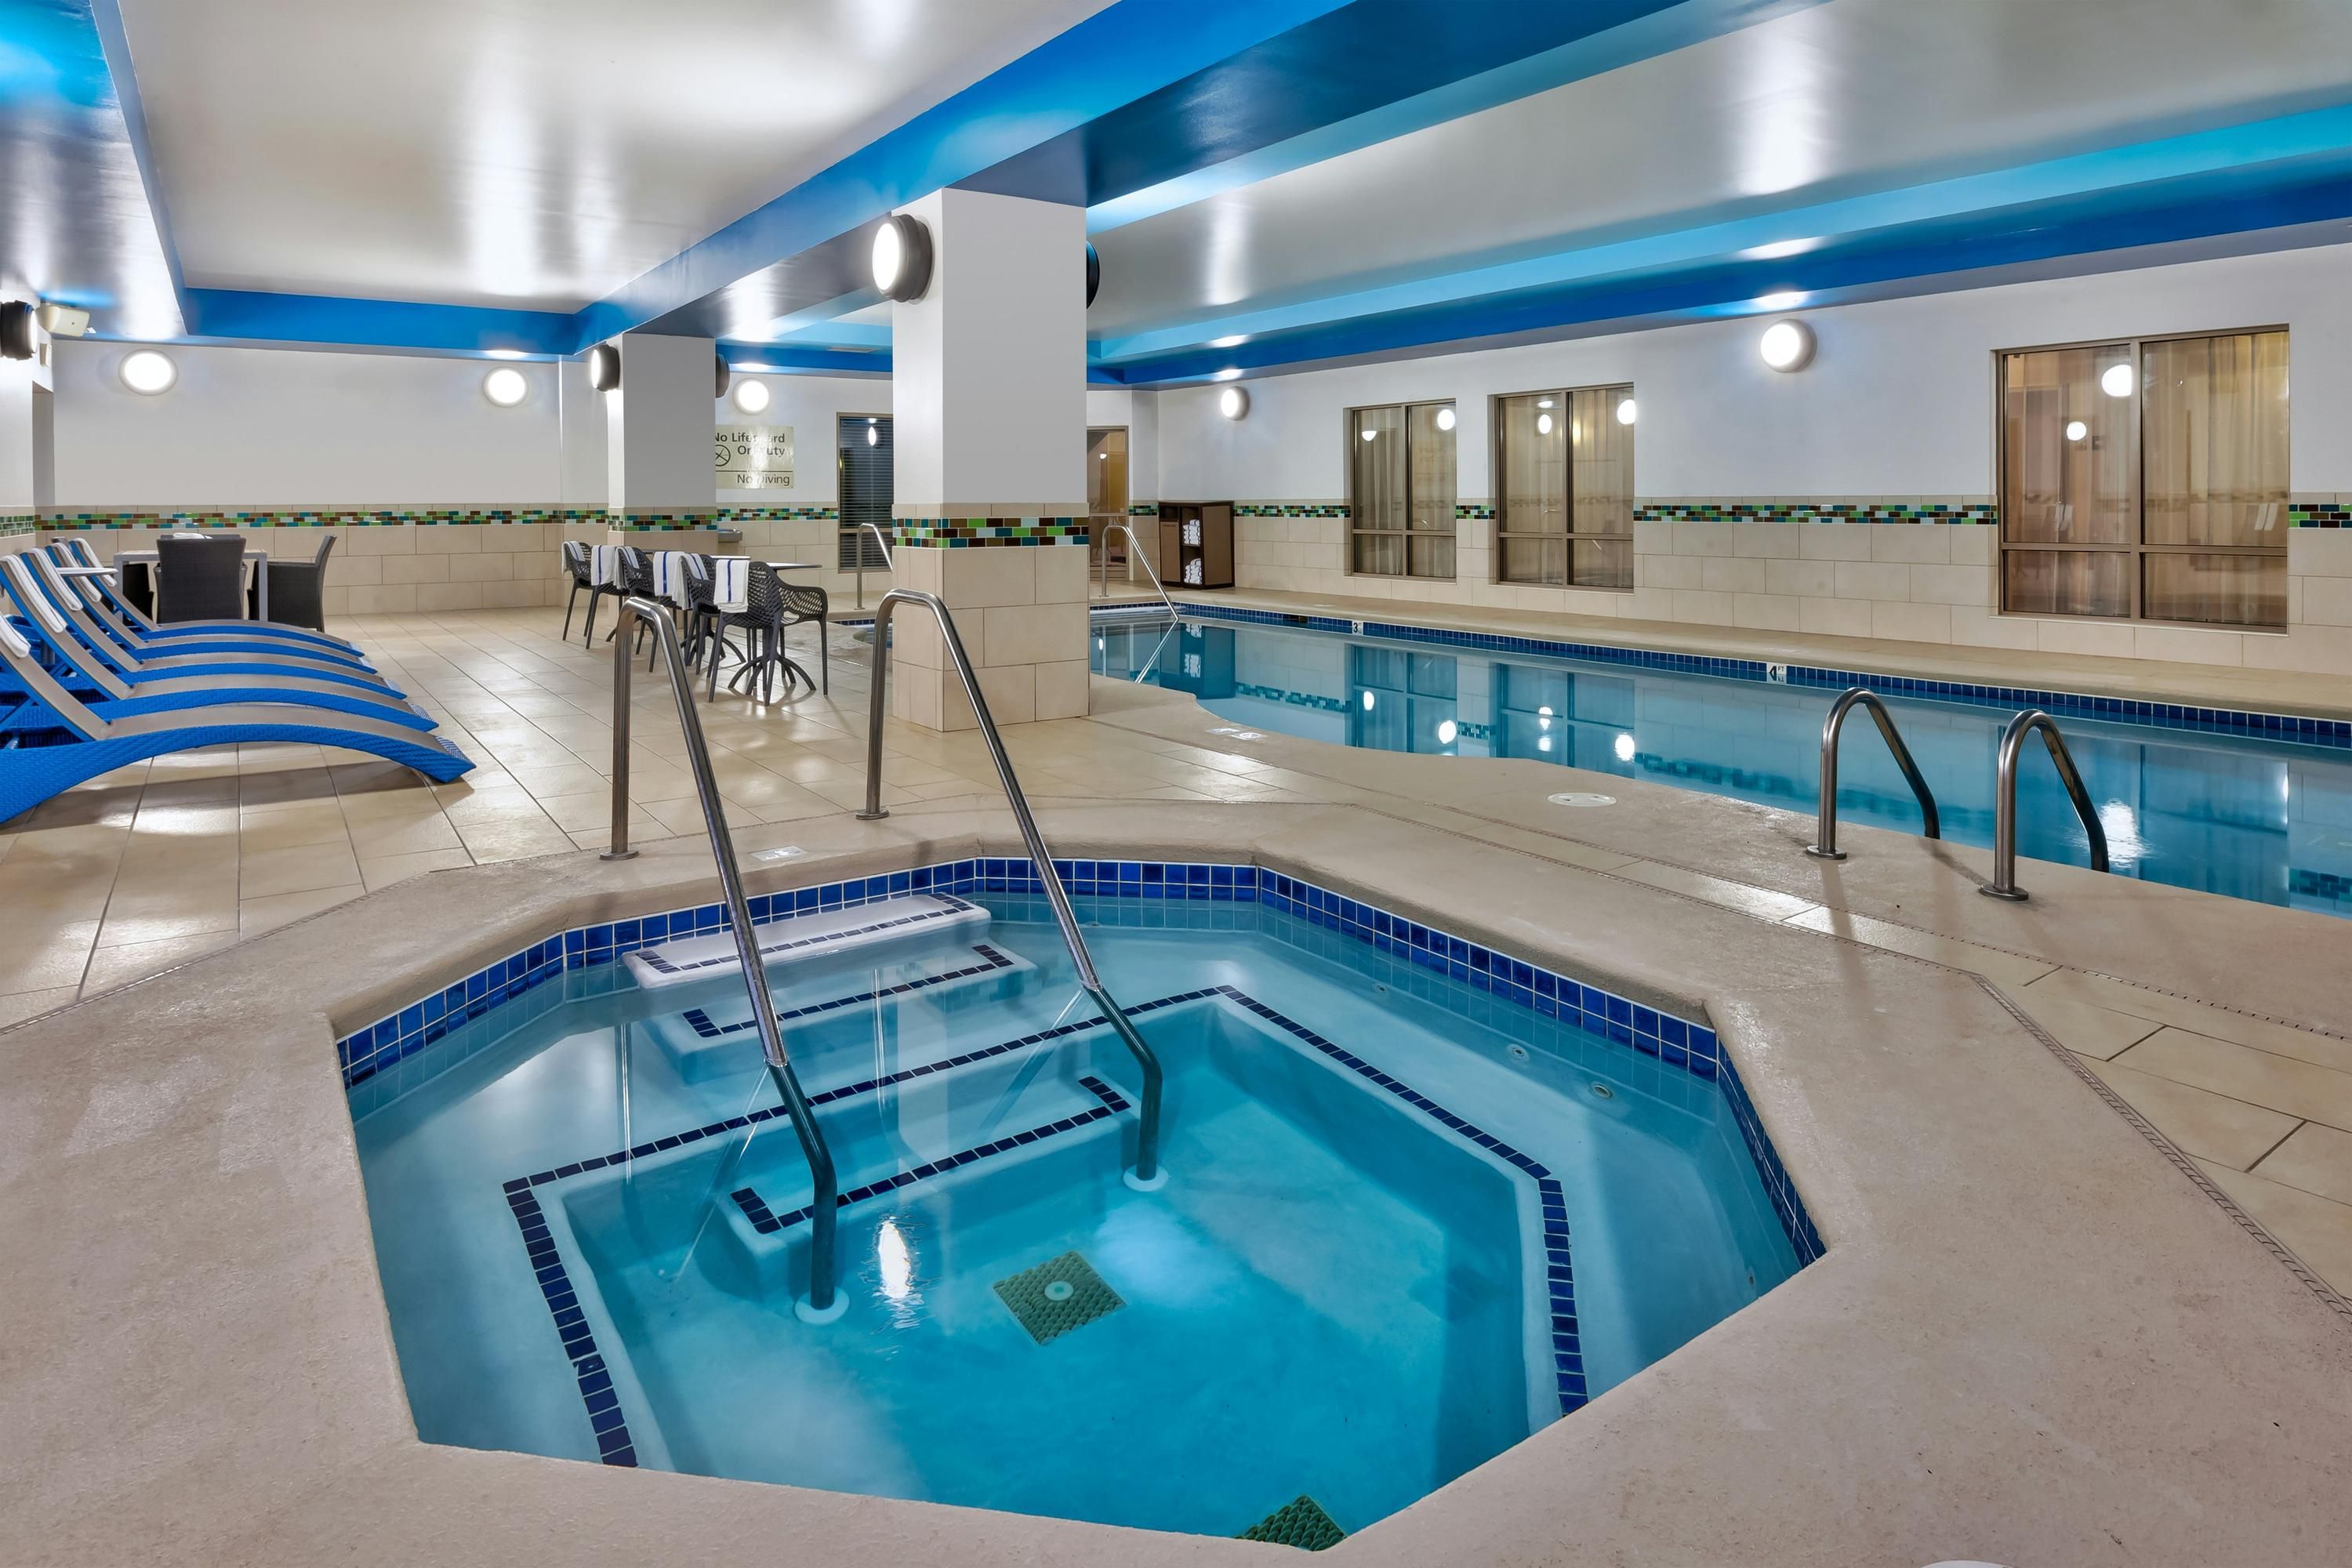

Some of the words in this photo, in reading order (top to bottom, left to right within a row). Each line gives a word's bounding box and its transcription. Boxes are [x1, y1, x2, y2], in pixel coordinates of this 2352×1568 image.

[732, 433, 785, 443] Liferd
[760, 446, 785, 458] uty
[737, 474, 753, 483] No
